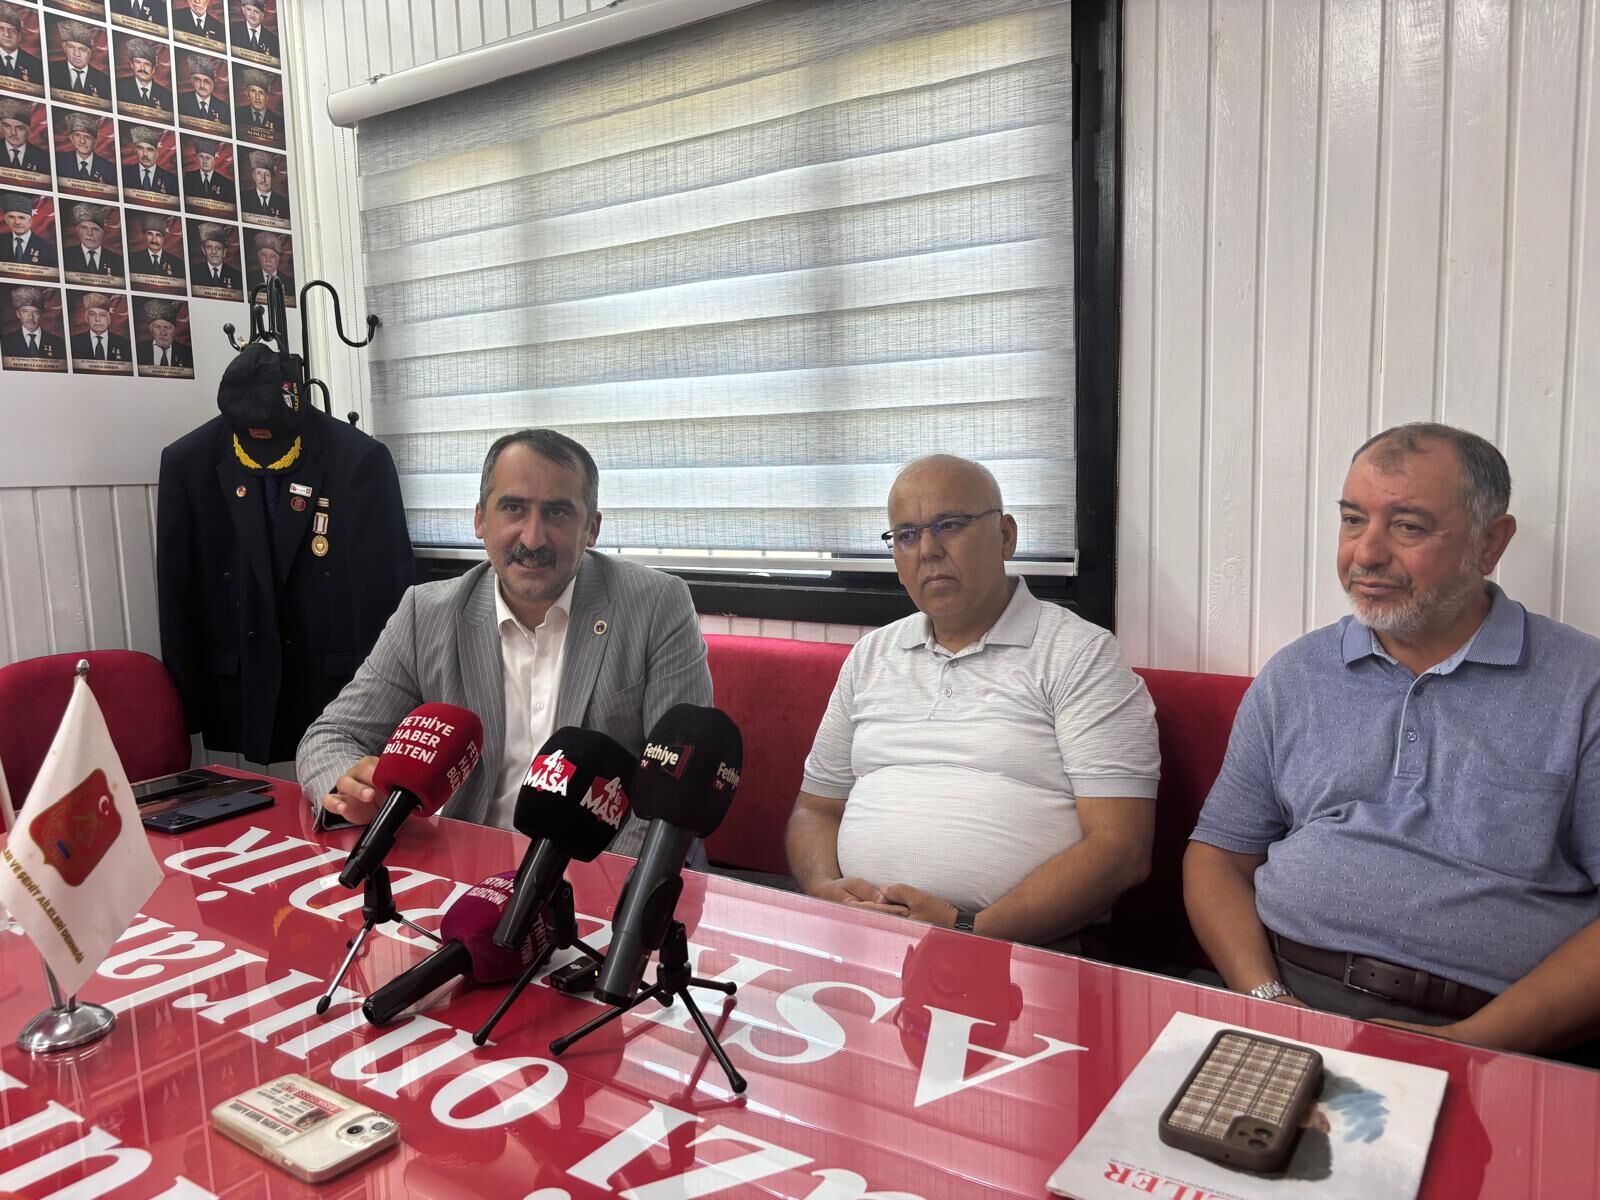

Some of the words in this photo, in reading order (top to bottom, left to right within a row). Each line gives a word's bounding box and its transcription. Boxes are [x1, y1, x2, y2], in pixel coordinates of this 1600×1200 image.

[399, 716, 455, 737] FETHİYE
[392, 729, 441, 748] HABER
[383, 741, 437, 764] BÜLTENİ
[643, 743, 679, 766] Fethiye
[523, 768, 567, 797] MASA
[580, 785, 625, 830] MASA
[480, 877, 514, 894] FETHİY
[16, 871, 42, 897] ŞEHİT
[36, 896, 67, 932] AİLELERİ
